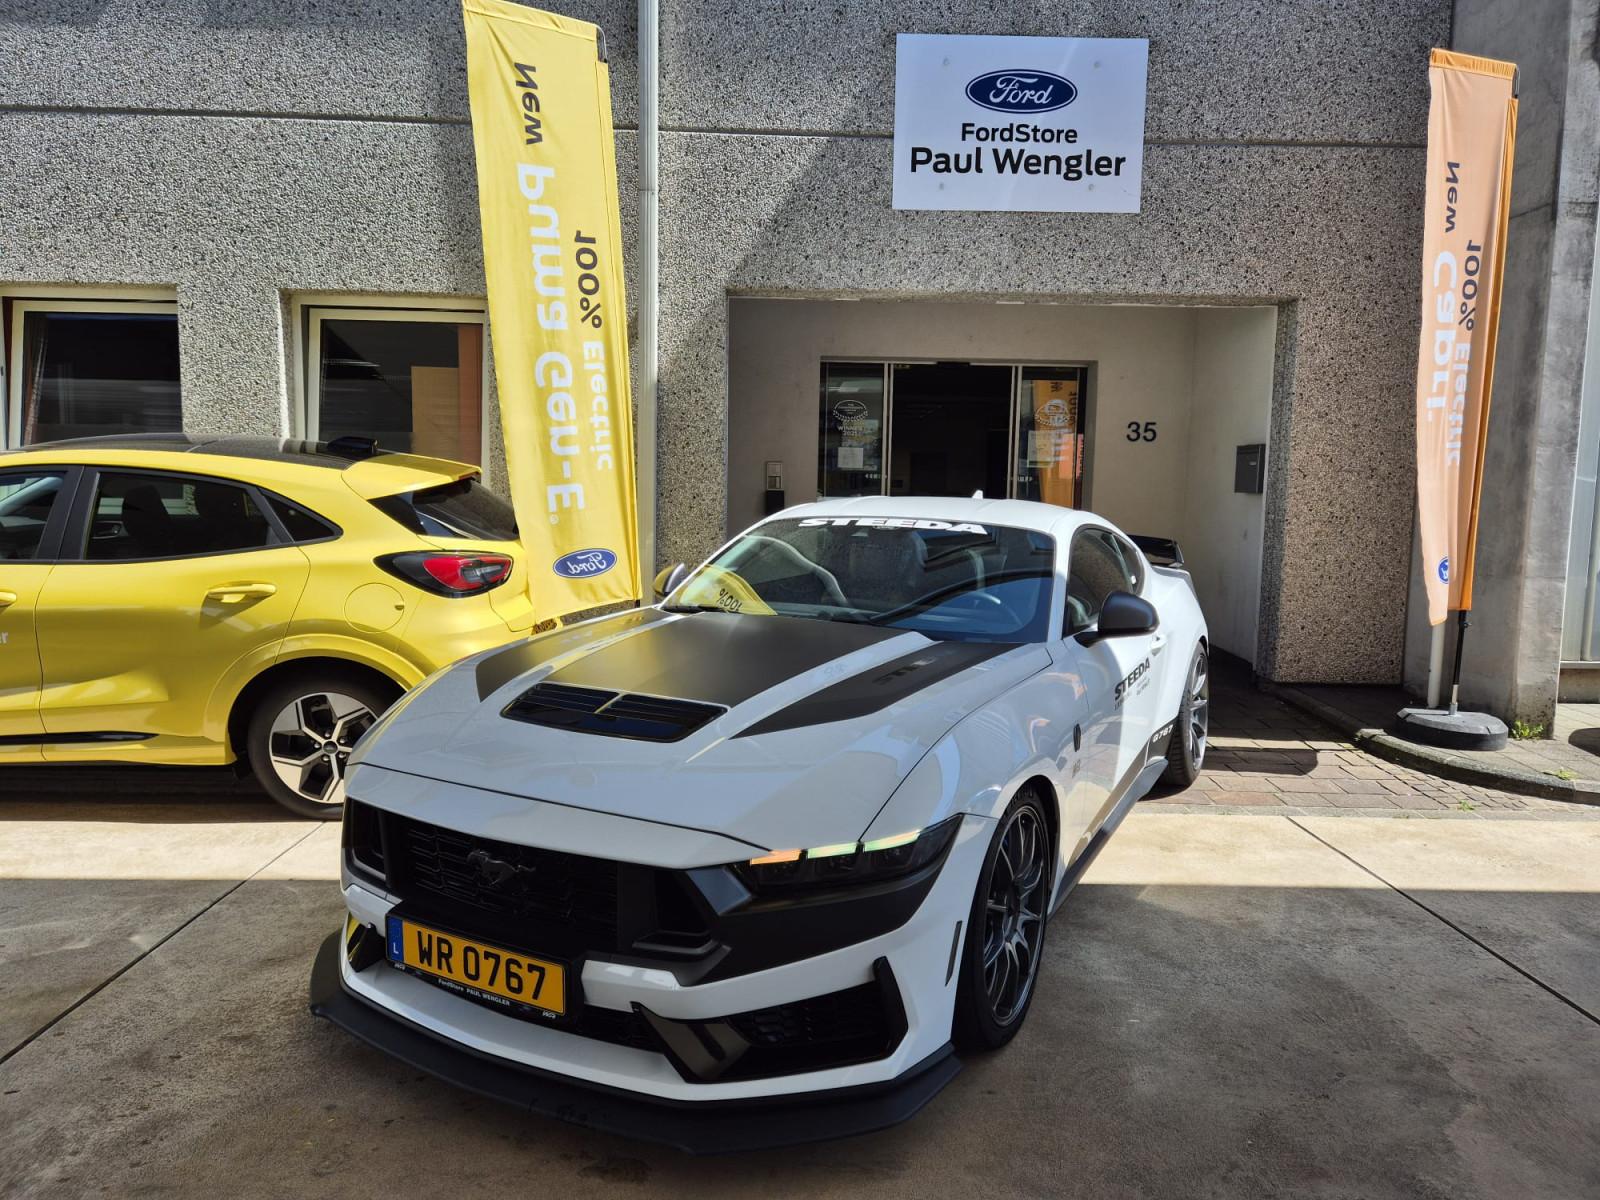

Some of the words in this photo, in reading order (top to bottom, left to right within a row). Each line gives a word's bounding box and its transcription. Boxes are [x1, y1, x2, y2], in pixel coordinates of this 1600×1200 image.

[989, 75, 1054, 104] Ford
[961, 123, 1078, 143] FordStore
[911, 147, 983, 174] Paul
[992, 148, 1127, 181] Wengler
[1126, 421, 1157, 442] 35
[799, 518, 987, 535] STEEDA
[1115, 657, 1150, 700] STEEDA
[393, 942, 399, 954] L
[417, 930, 453, 974] WR
[463, 945, 546, 1001] 0767
